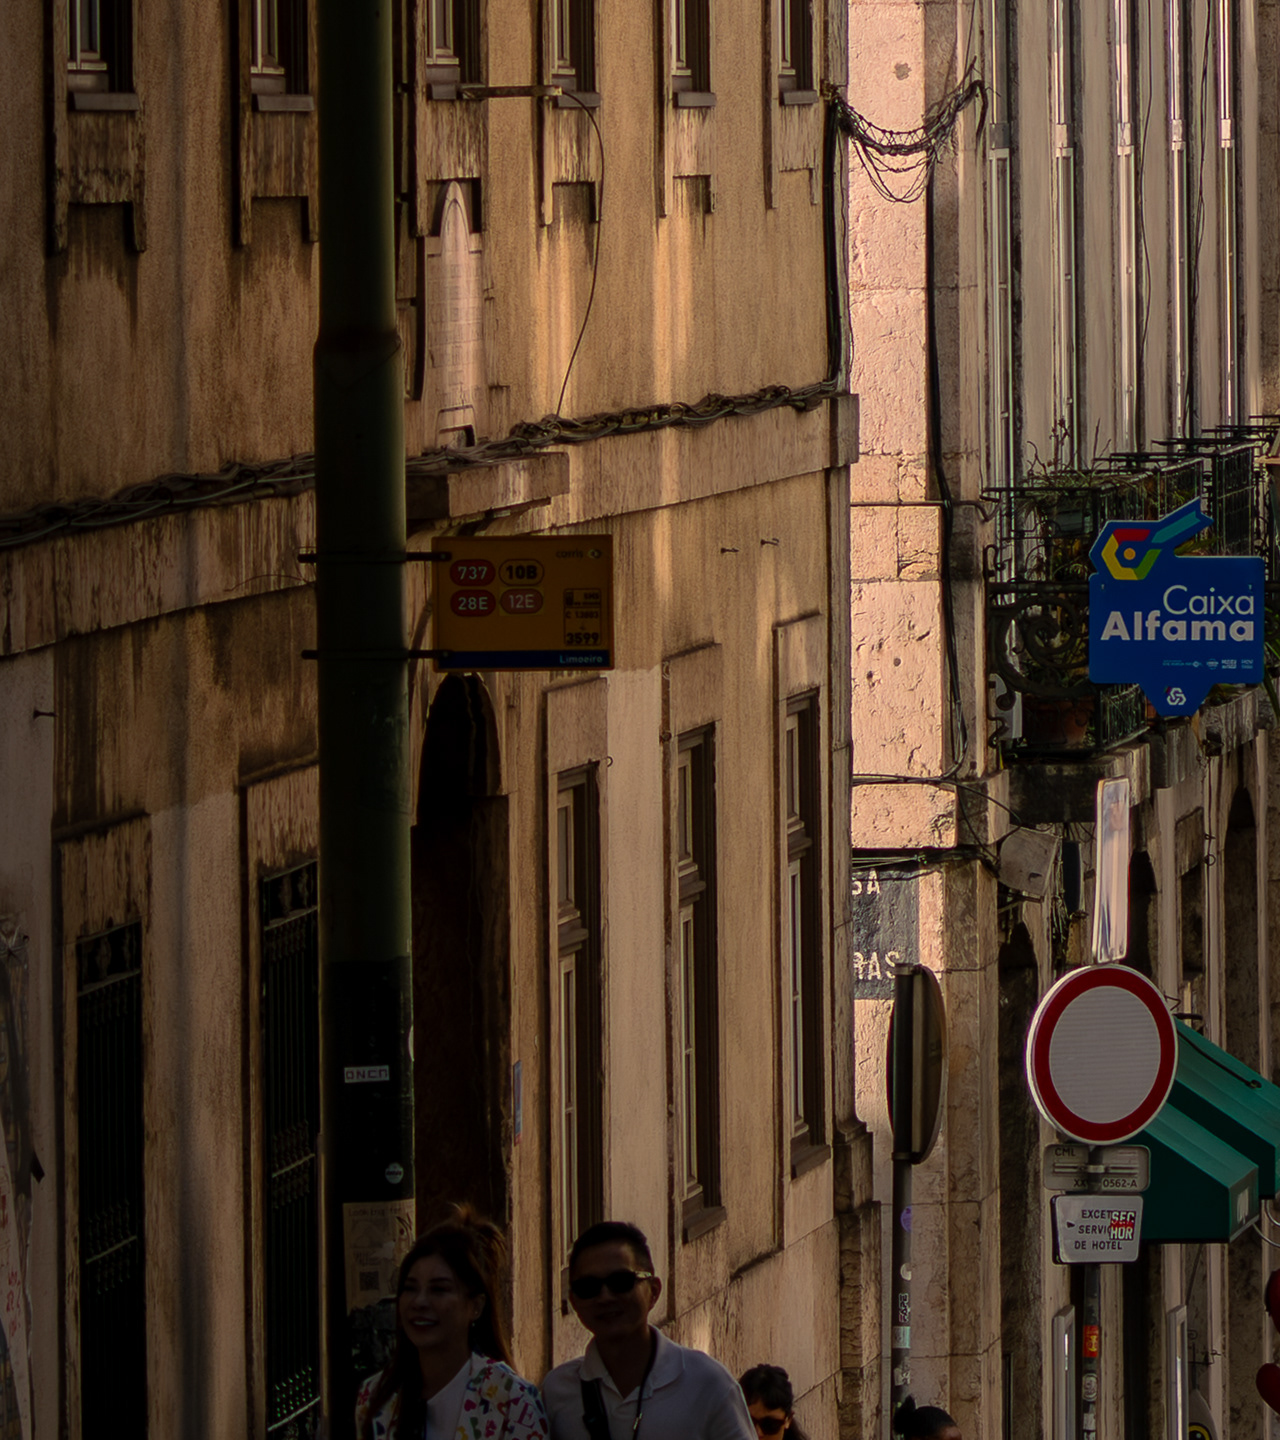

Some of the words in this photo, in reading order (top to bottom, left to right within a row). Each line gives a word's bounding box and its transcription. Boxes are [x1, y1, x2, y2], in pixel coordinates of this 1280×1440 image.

[457, 566, 487, 580] 737
[506, 565, 537, 579] 10B
[457, 596, 488, 610] 28E
[509, 594, 535, 608] 12E
[1163, 585, 1254, 615] Caixa
[1101, 610, 1254, 642] Alfama
[567, 632, 599, 644] 3599
[559, 653, 603, 664] Limoeiro
[1054, 1148, 1076, 1157] CML
[1081, 1209, 1111, 1219] EXCET
[1074, 1241, 1086, 1250] DE
[1092, 1241, 1122, 1250] HOTEL
